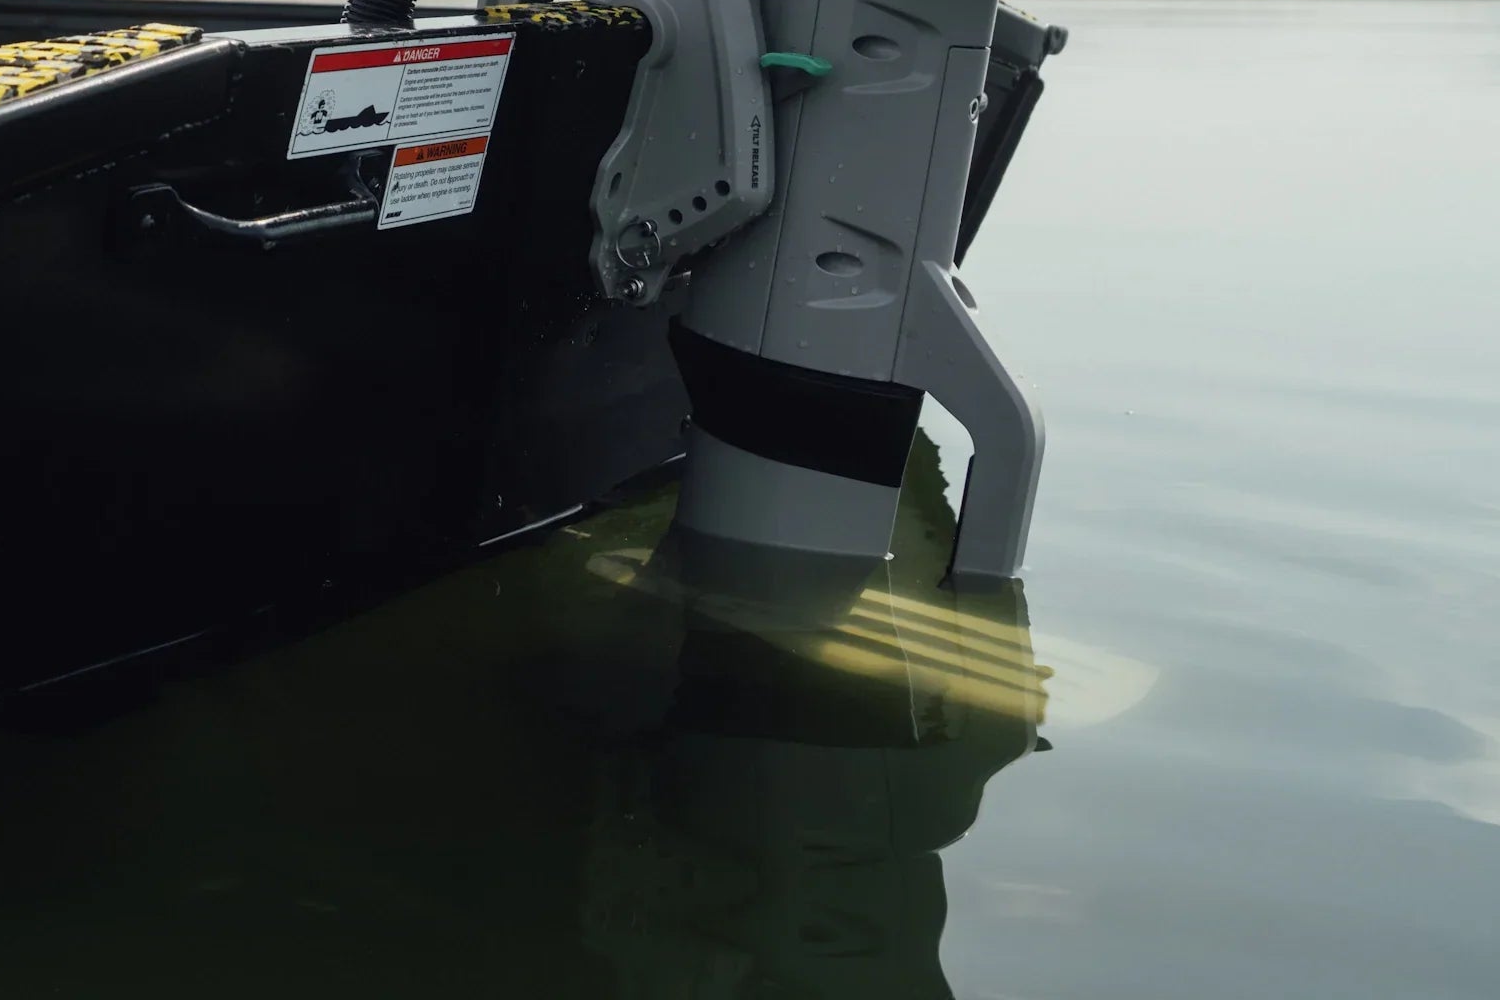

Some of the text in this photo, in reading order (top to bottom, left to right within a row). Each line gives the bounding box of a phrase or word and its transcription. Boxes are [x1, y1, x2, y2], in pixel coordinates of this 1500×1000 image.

[402, 48, 440, 62] DANGER
[426, 142, 468, 158] WARNING
[751, 128, 760, 189] TILT RELEASE
[393, 161, 480, 180] Rotating propeller may cause serious
[430, 178, 438, 186] Do
[438, 177, 447, 185] not
[469, 172, 476, 180] or
[400, 194, 416, 203] ladder
[430, 188, 448, 199] engine
